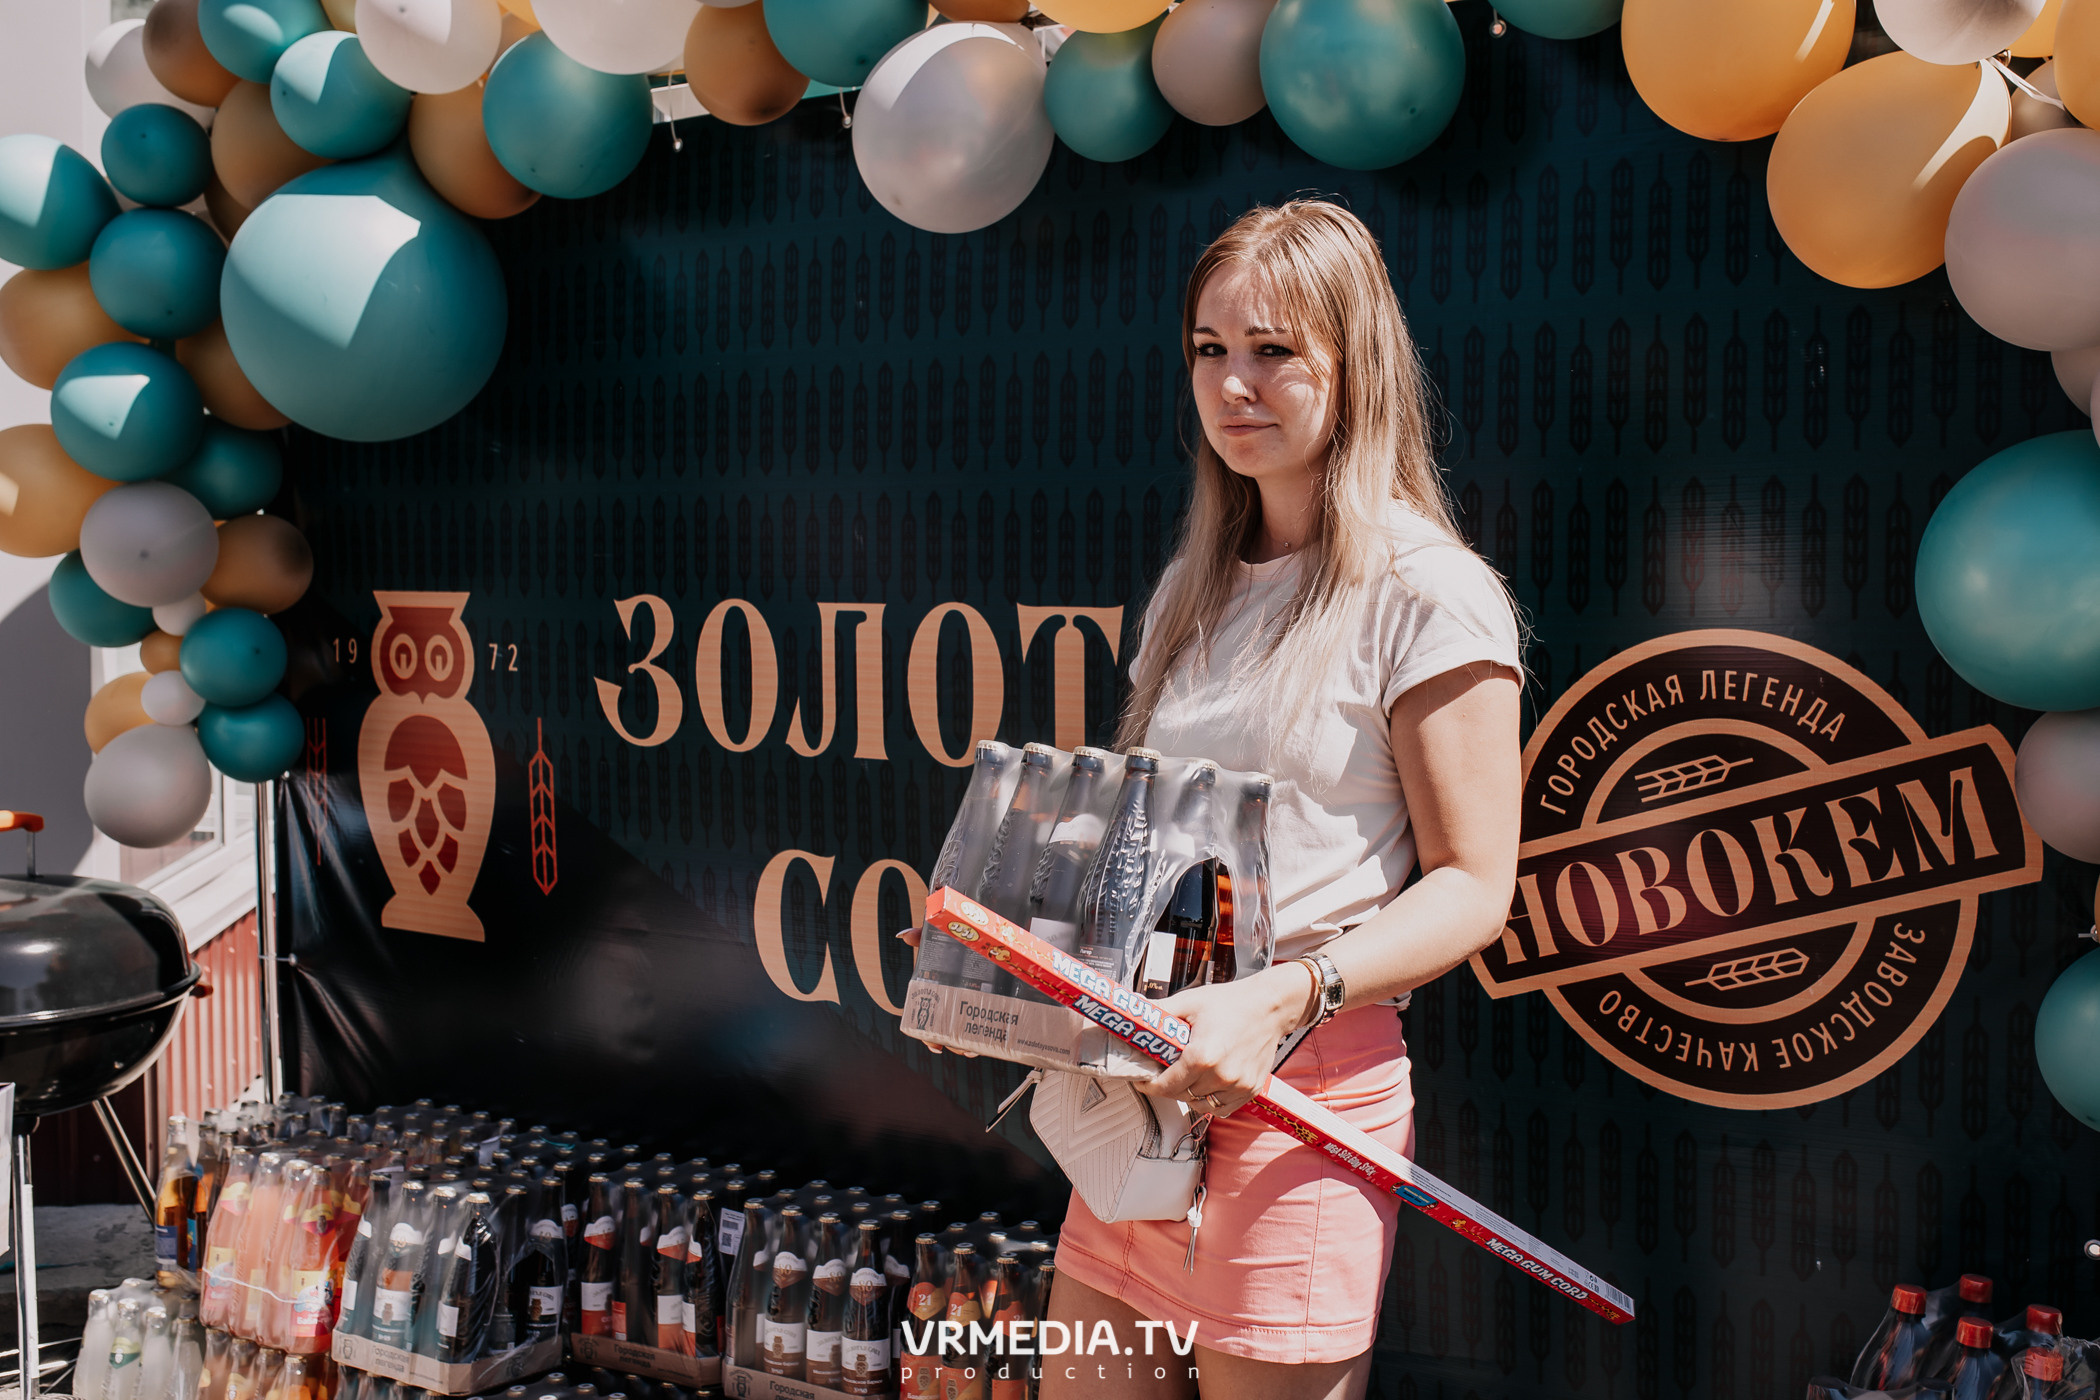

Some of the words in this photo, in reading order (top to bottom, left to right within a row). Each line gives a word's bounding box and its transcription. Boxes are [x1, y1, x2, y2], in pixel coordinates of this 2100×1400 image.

[332, 639, 358, 665] 19
[488, 643, 518, 672] 72
[594, 594, 1124, 767] ЗОЛОТ
[1540, 674, 1685, 815] ГОРОДСКАЯ
[1699, 669, 1846, 743] ЛЕГЕНДА
[1502, 766, 2000, 966] НОВОКЕМ
[959, 1001, 1019, 1026] Городская
[1052, 949, 1111, 1000] MEGA
[1112, 987, 1162, 1029] GUM
[1772, 922, 1925, 1070] ЗАВОДСКОЕ
[964, 1024, 1008, 1043] легенда
[1072, 994, 1136, 1038] MEGA
[1130, 1029, 1183, 1065] GUM
[1599, 989, 1759, 1072] КАЧЕСТВО
[1486, 1237, 1524, 1265] MEGA
[1519, 1258, 1555, 1281] GUM
[1550, 1276, 1589, 1301] CORD
[770, 1380, 815, 1400] Городская
